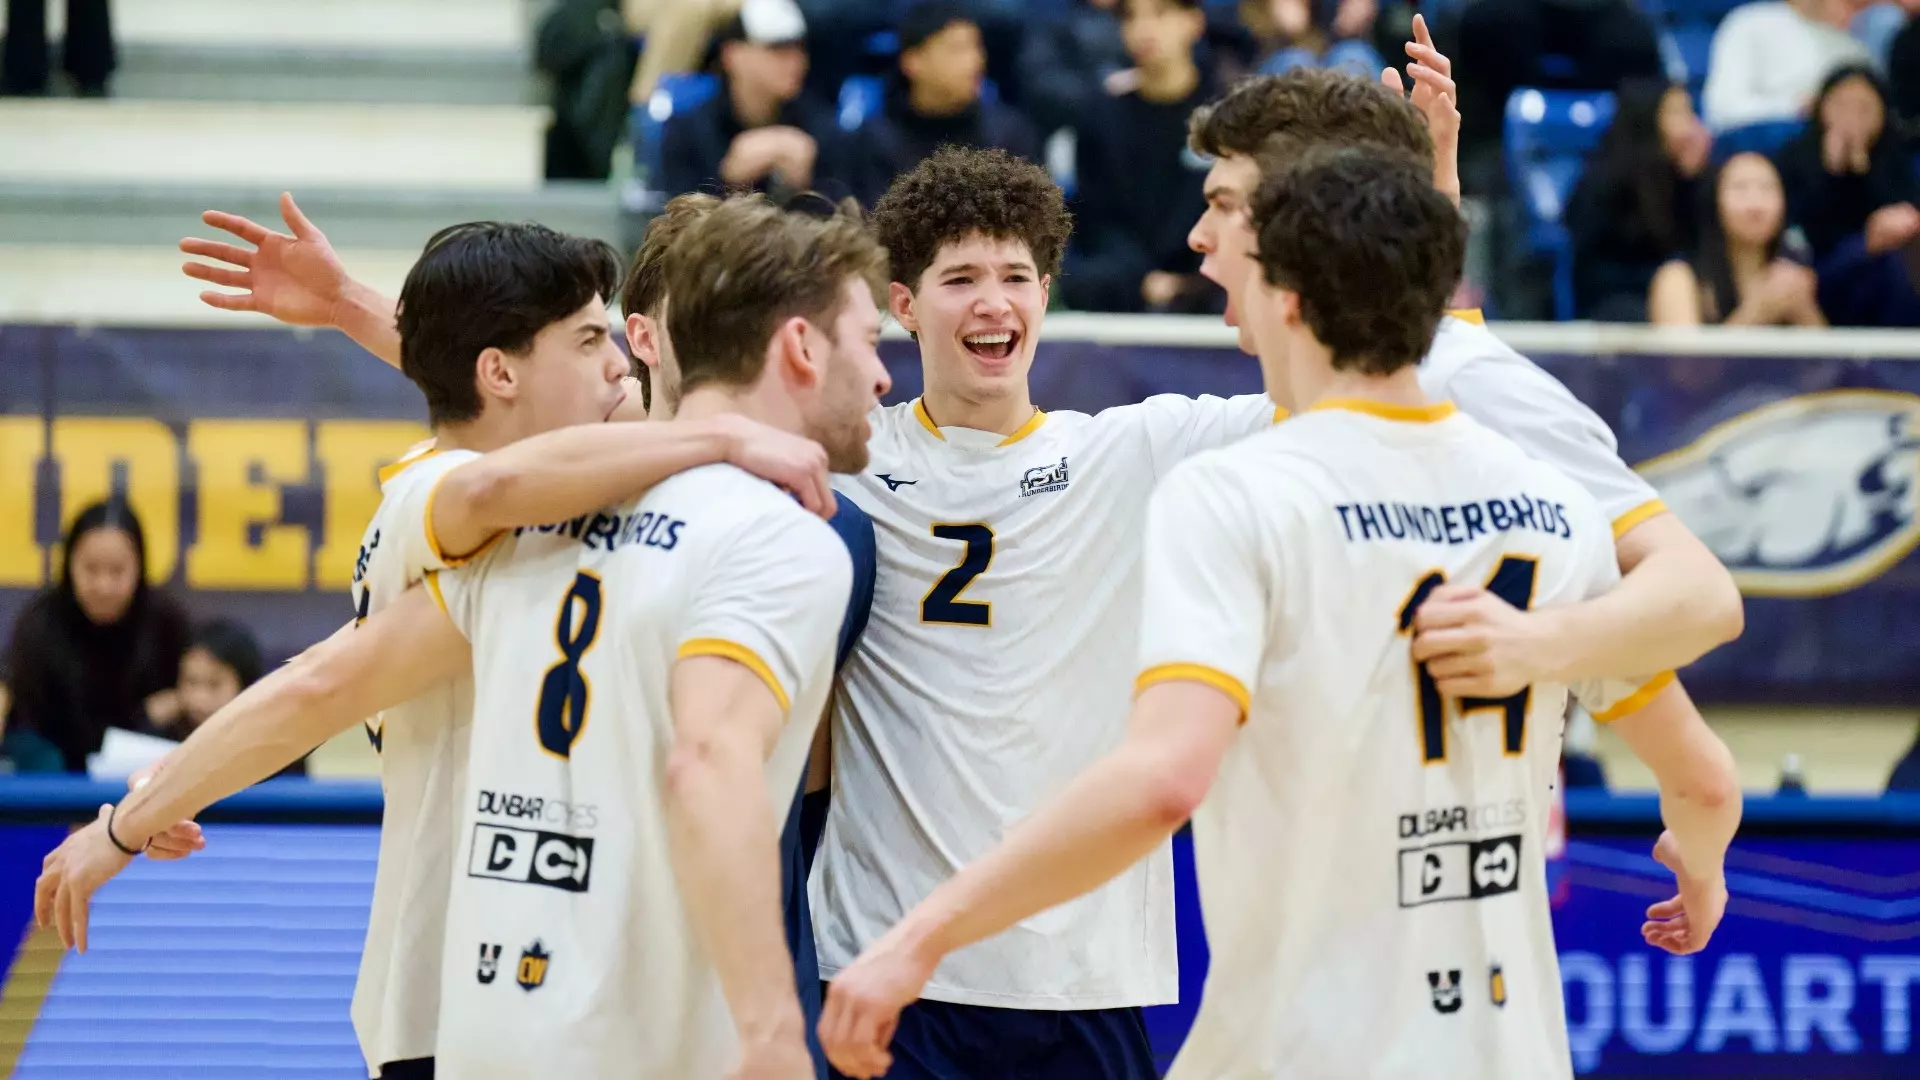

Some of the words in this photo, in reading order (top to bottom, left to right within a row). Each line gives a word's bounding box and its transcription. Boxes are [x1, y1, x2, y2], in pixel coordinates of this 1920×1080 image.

[534, 569, 605, 762] 8
[919, 522, 995, 628] 2
[1395, 554, 1540, 766] 14
